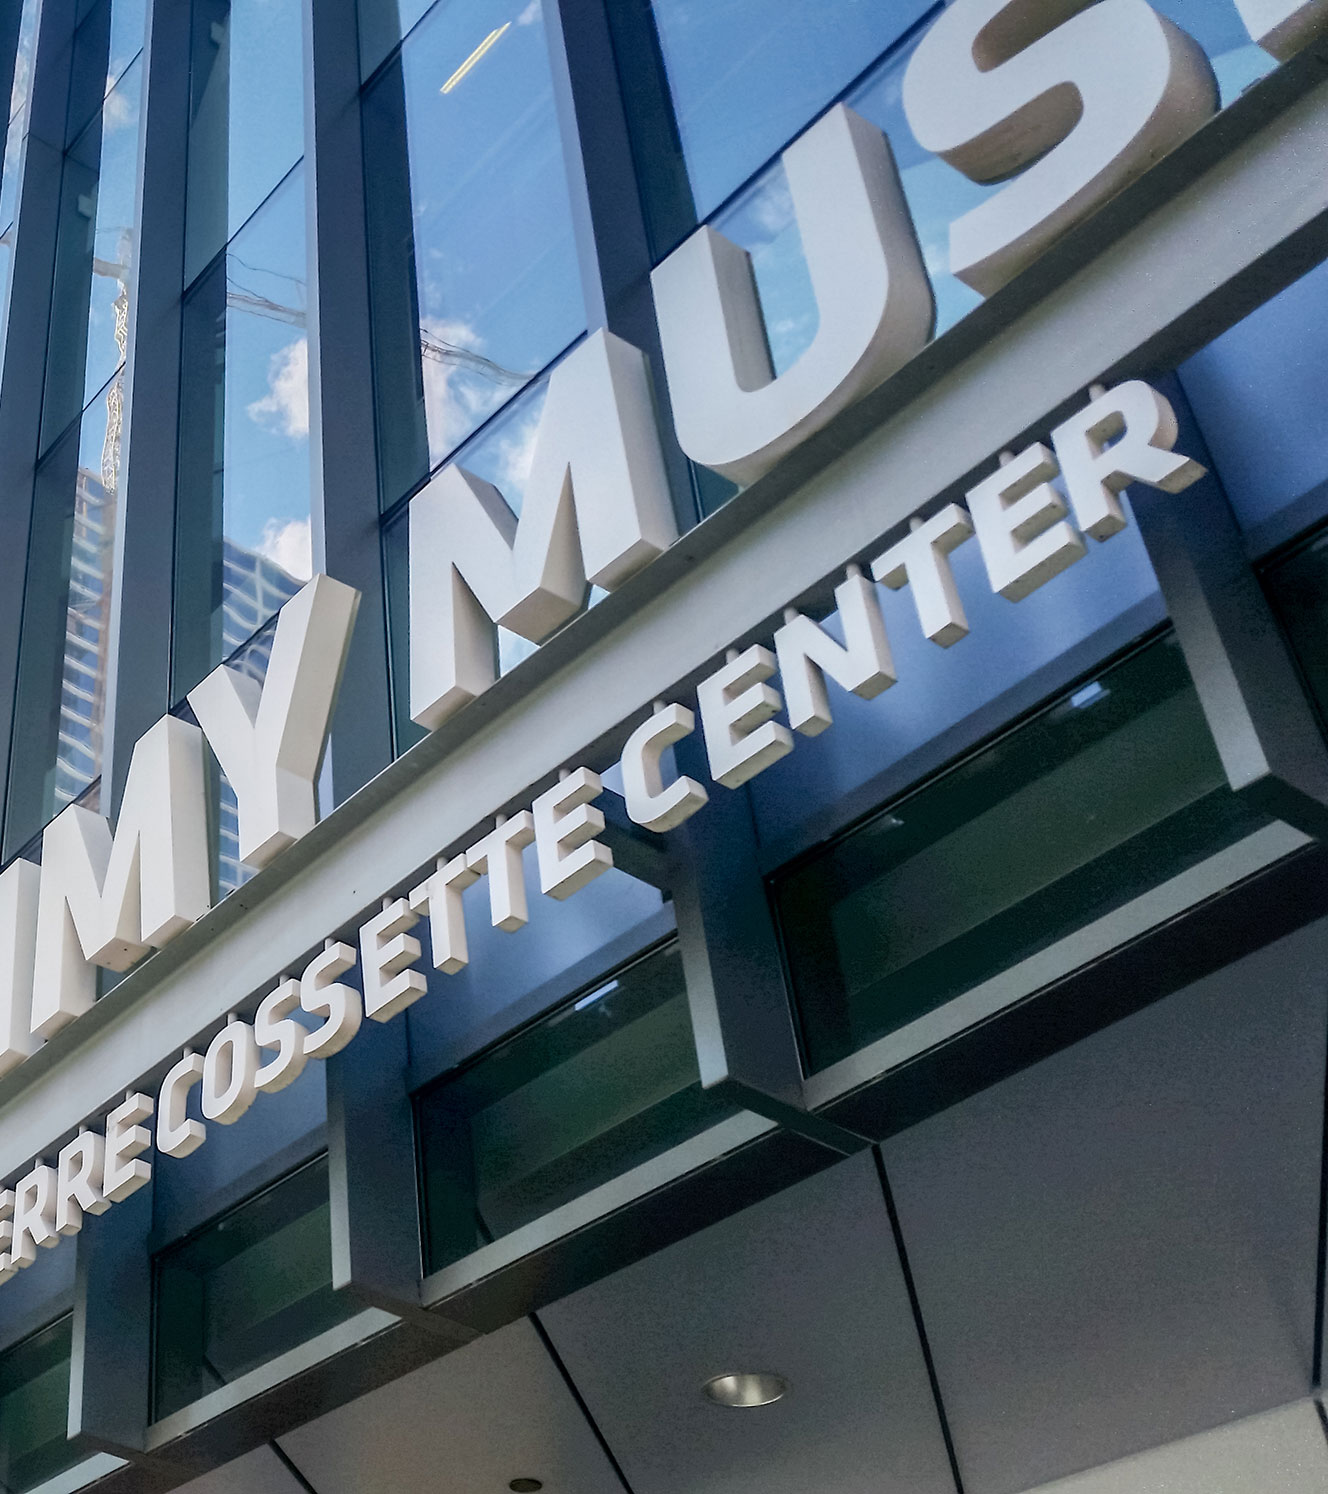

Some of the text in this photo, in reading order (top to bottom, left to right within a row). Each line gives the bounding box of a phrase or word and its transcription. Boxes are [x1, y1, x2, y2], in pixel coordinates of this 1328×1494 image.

[409, 0, 1328, 734] MUS
[156, 766, 614, 1159] COSSETTE
[620, 379, 1208, 833] CENTER
